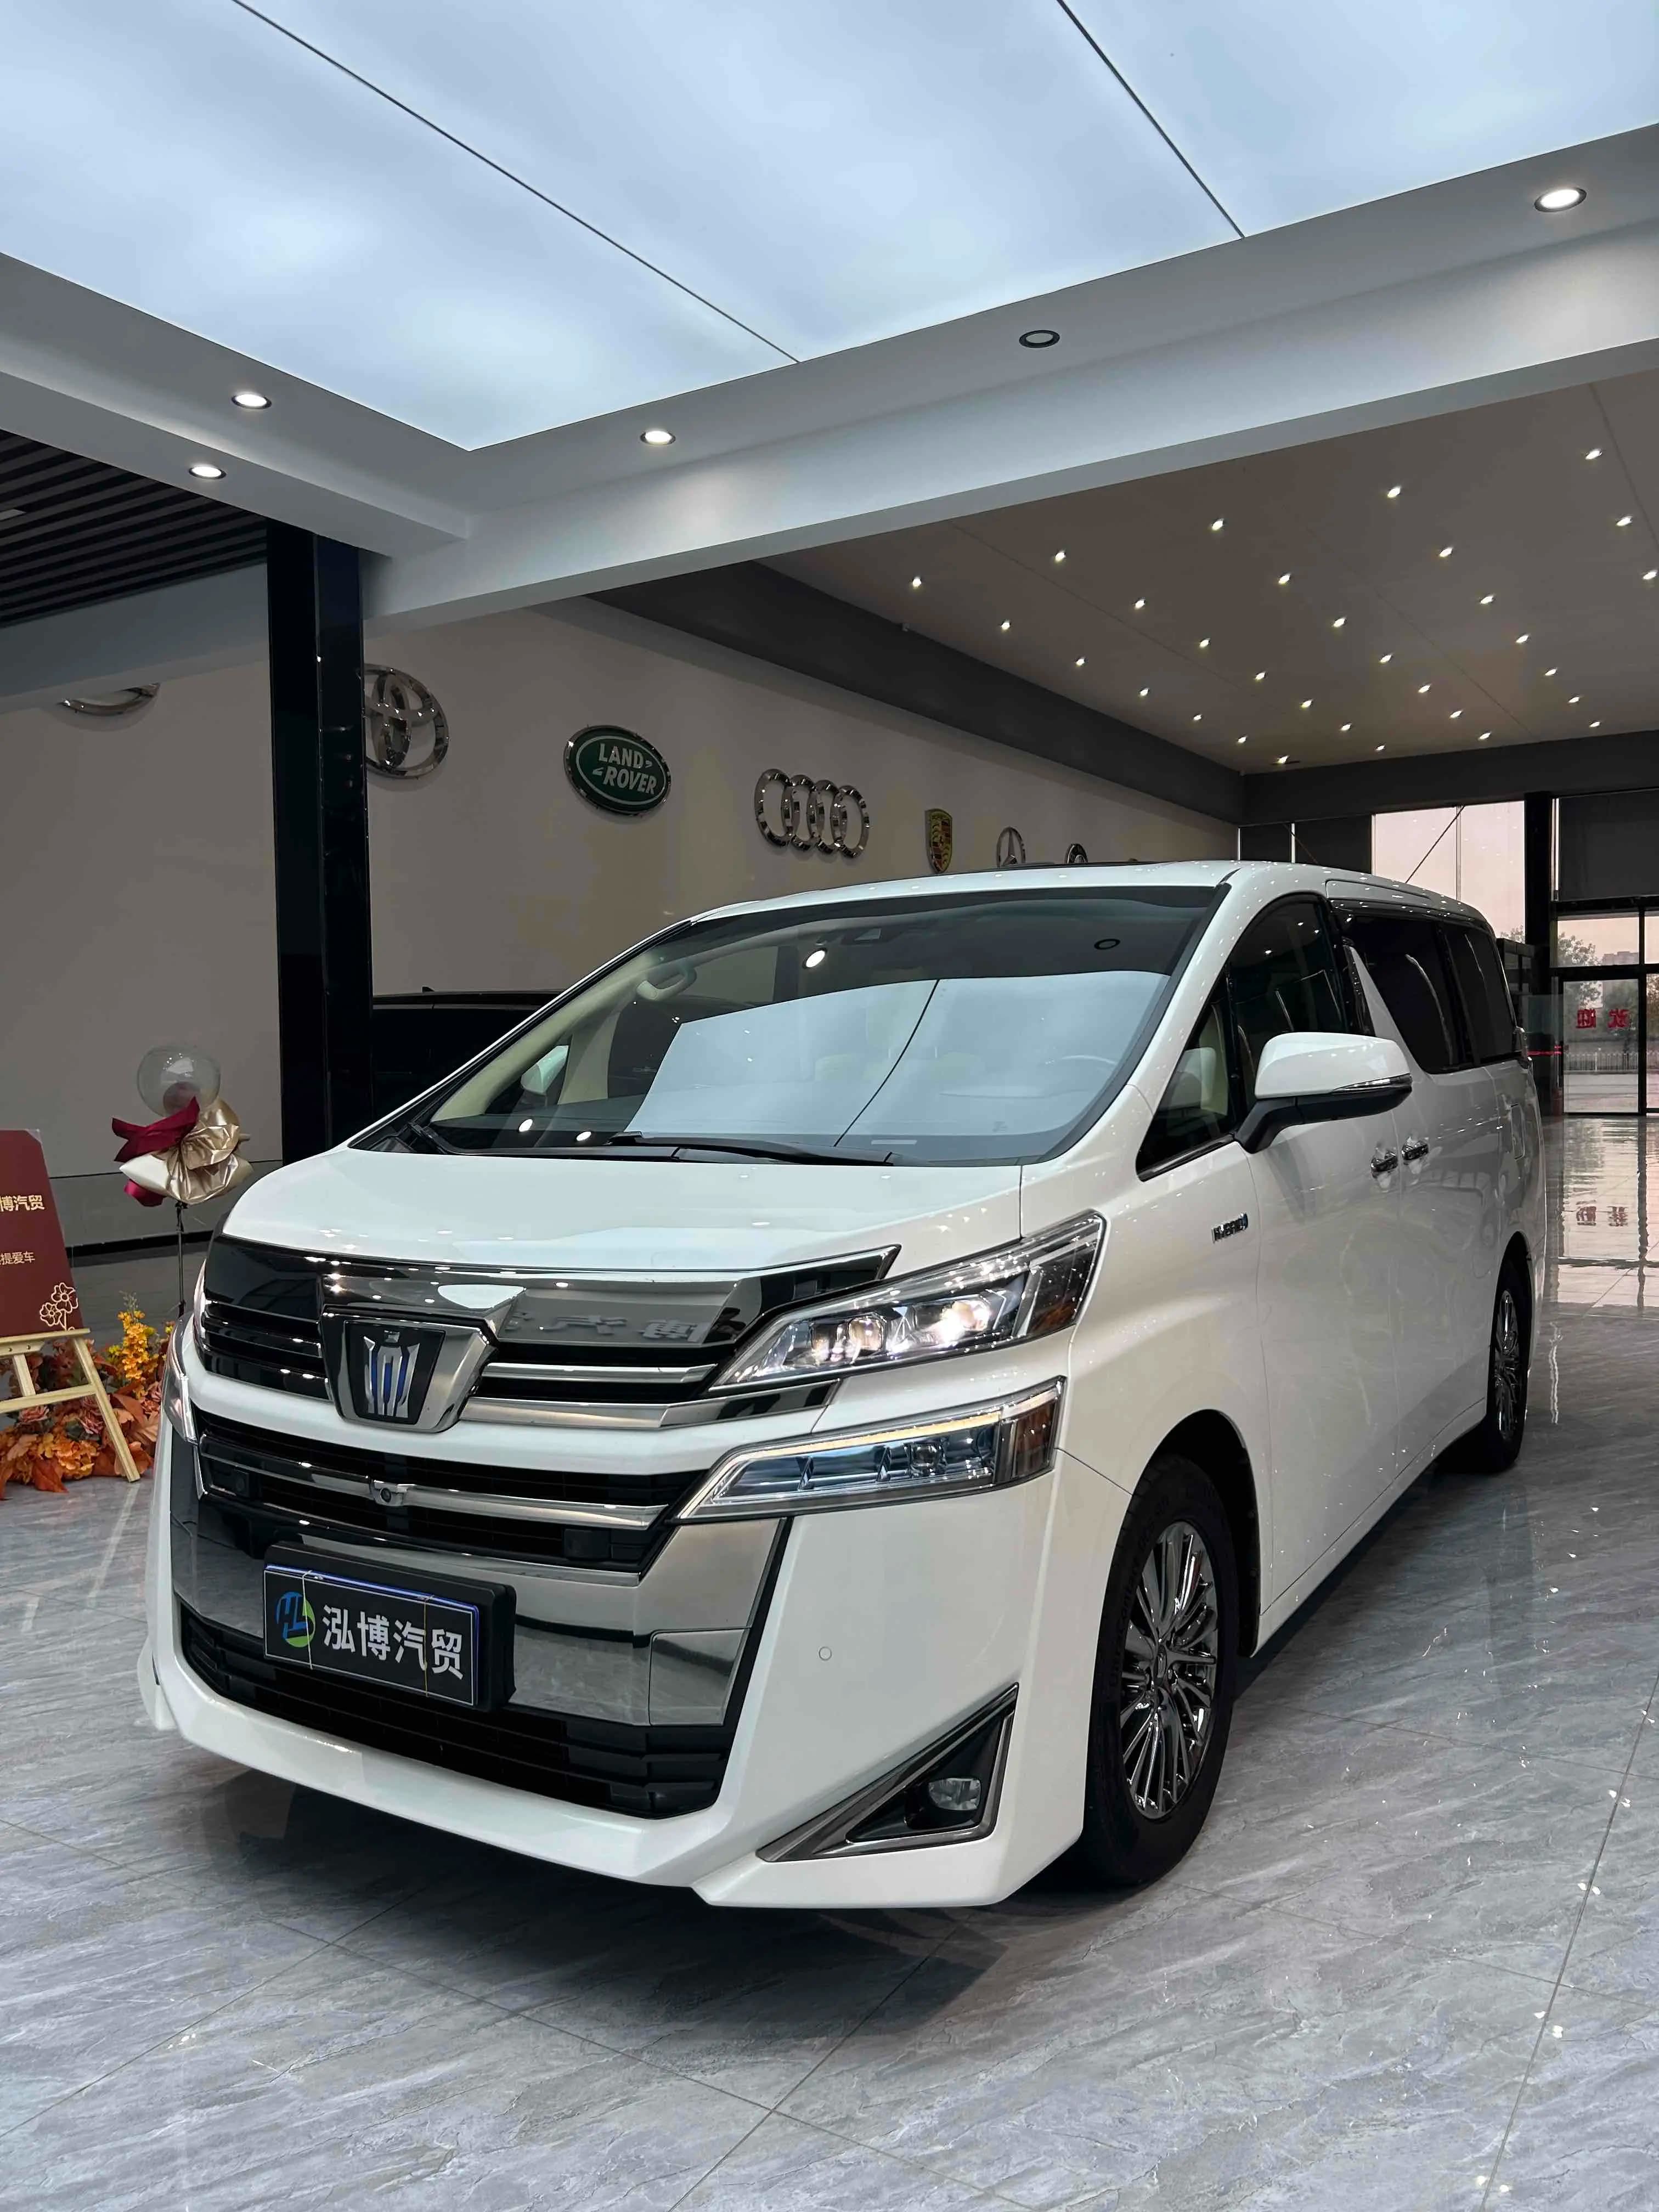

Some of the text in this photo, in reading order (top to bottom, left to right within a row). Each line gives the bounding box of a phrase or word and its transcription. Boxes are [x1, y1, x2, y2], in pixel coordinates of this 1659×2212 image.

[599, 743, 644, 769] LAND
[603, 766, 657, 795] ROVER
[0, 1195, 45, 1212] 博汽贸
[0, 1251, 36, 1265] 提爱车
[322, 1605, 464, 1680] 泓博汽贸
